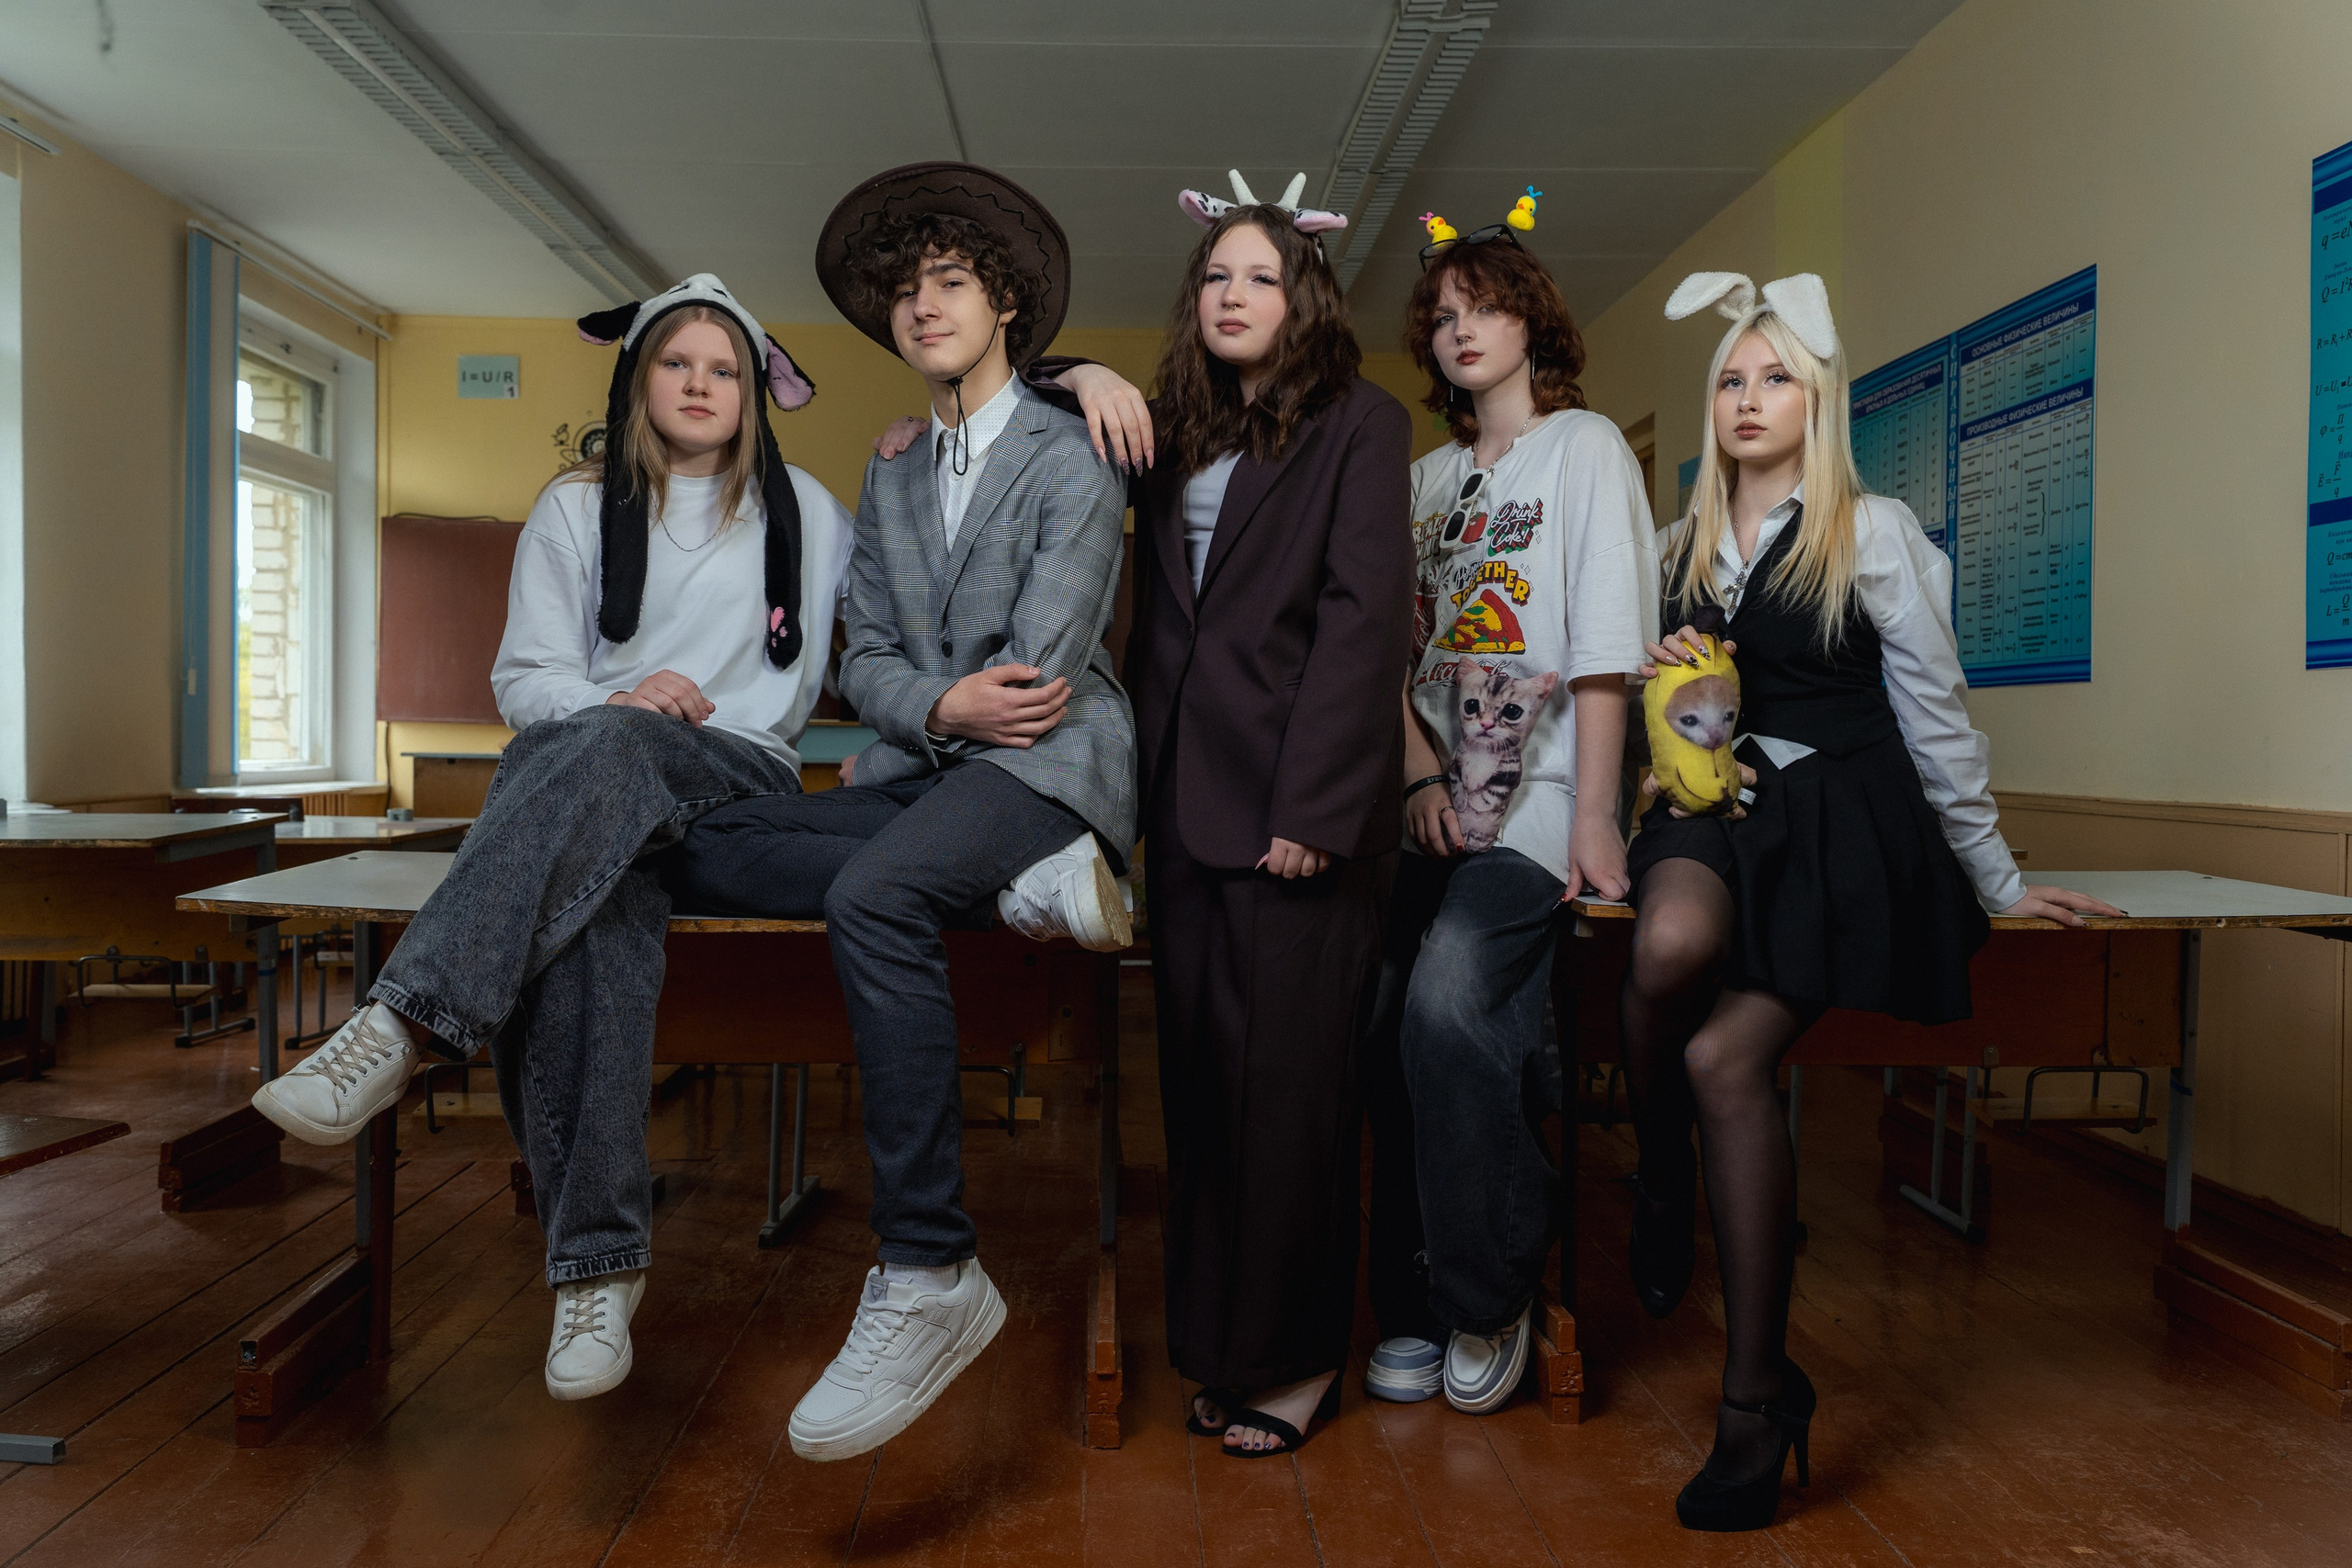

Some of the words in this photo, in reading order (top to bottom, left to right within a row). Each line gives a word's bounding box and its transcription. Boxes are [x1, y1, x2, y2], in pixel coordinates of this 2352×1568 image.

[1972, 336, 2003, 357] ОСНОВНЫЕ
[2003, 321, 2042, 344] ФИЗИЧЕСКИЕ
[2042, 302, 2079, 327] ВЕЛИЧИНЫ
[507, 386, 514, 398] 1
[1966, 414, 2008, 436] ПРОИЗВОДНЫЕ
[2008, 401, 2048, 423] ФИЗИЧЕСКИЕ
[2048, 387, 2084, 409] ВЕЛИЧИНЫ
[1490, 498, 1542, 528] Drink
[1491, 522, 1532, 549] Coke!
[1451, 561, 1530, 612] TOGETHER
